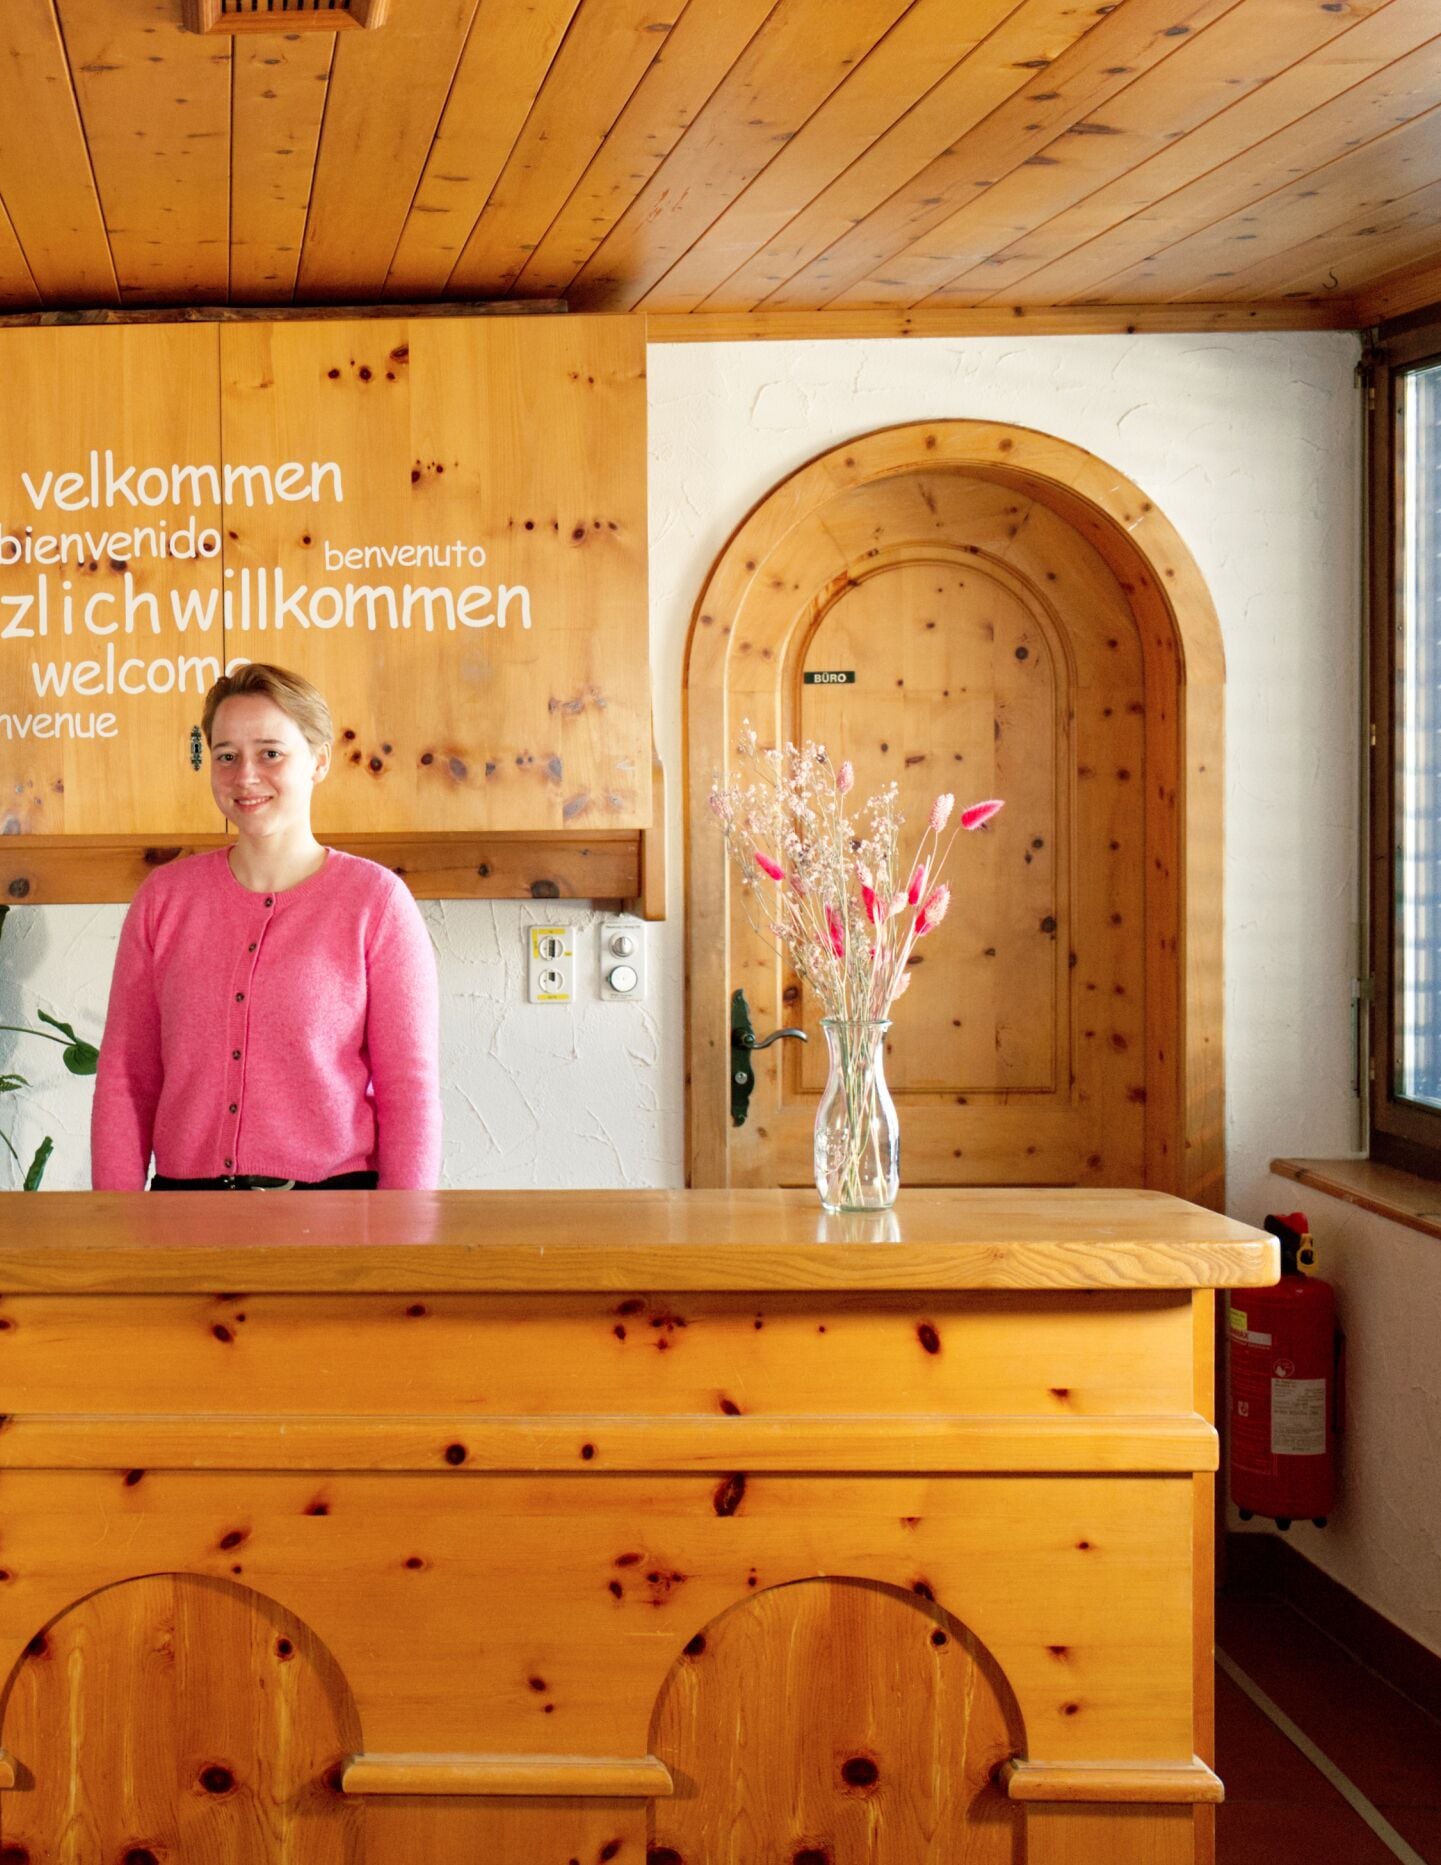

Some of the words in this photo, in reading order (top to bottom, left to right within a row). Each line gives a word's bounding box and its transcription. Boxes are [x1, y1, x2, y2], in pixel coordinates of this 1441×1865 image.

[21, 449, 344, 511] velkommen
[324, 540, 487, 571] benvenuto
[171, 567, 533, 632] willkommen
[813, 672, 847, 683] BÜRO
